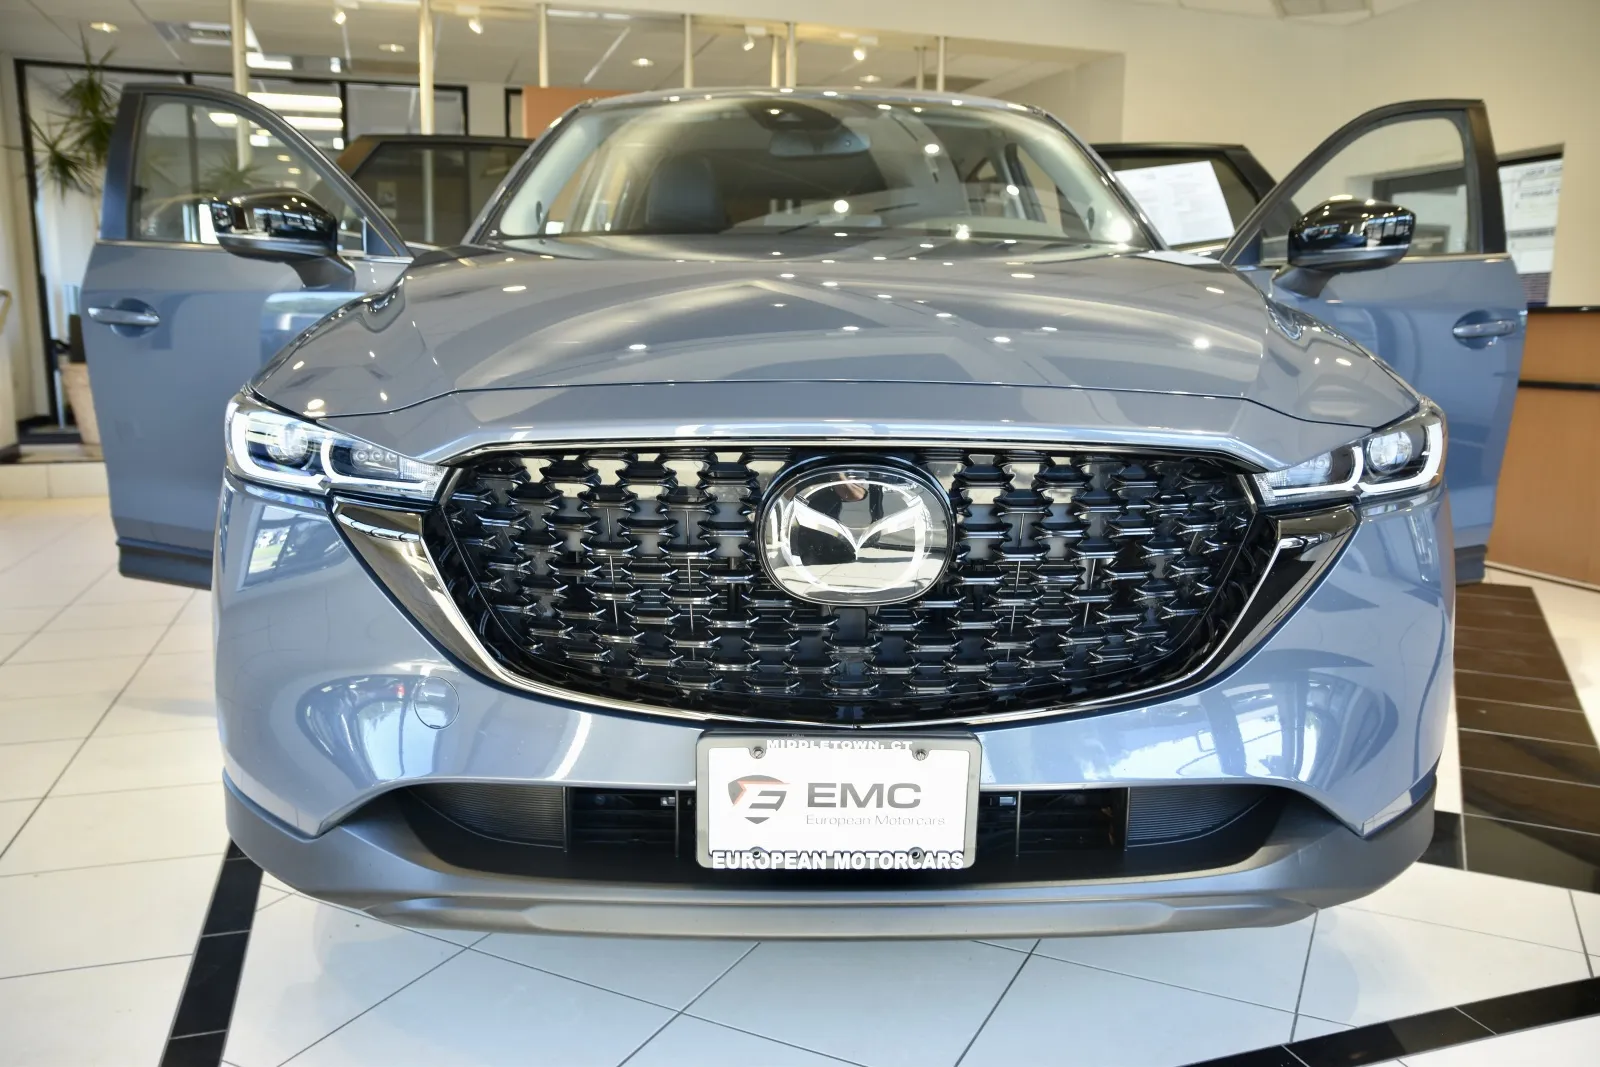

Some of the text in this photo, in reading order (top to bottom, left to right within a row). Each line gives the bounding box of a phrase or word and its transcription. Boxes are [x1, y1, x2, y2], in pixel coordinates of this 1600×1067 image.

[891, 740, 913, 750] CT
[807, 782, 922, 809] EMC
[805, 815, 946, 827] European Motorcars
[712, 851, 964, 870] EUROPEAN MOTORCARS
